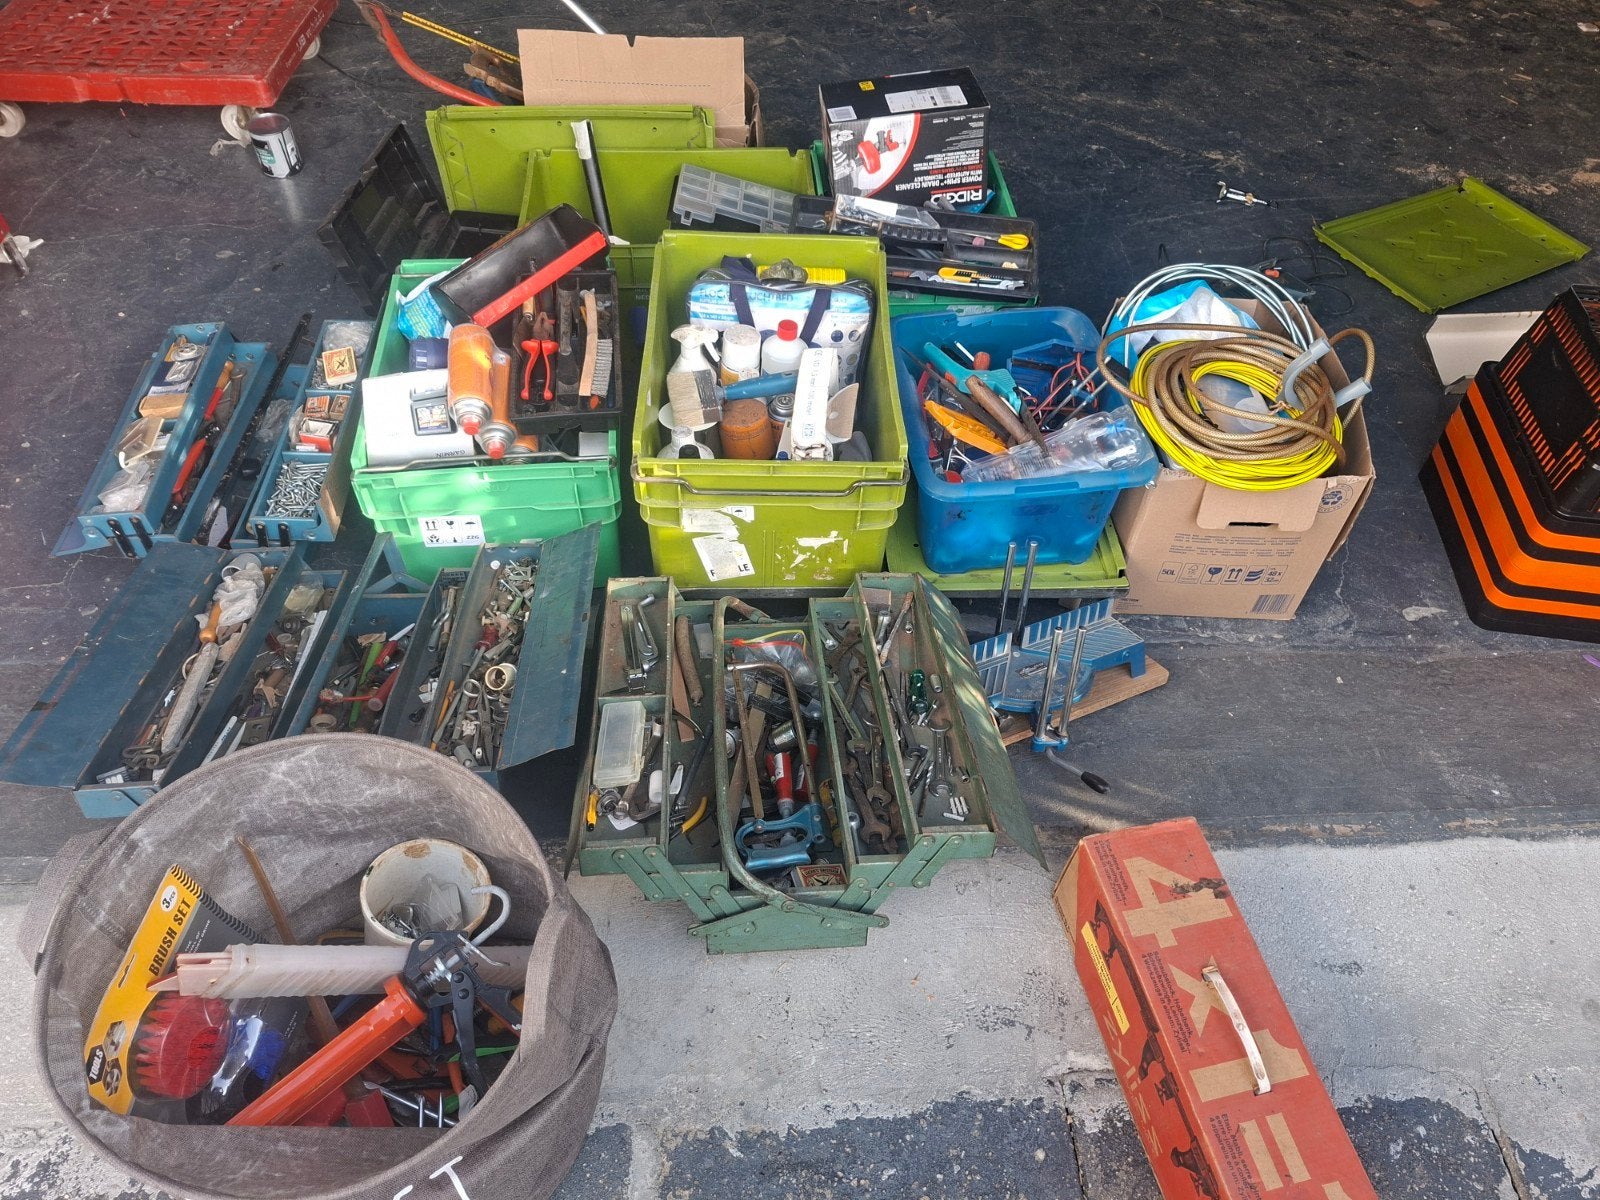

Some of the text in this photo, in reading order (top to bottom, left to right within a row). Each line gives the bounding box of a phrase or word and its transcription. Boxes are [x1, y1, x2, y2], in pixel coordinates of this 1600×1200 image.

[961, 174, 982, 182] POWER
[895, 182, 920, 190] CLEANER
[929, 189, 983, 205] RIDGD
[436, 449, 465, 457] GARMIN
[147, 897, 192, 976] BRUSH SET
[89, 1048, 105, 1079] TOOLS
